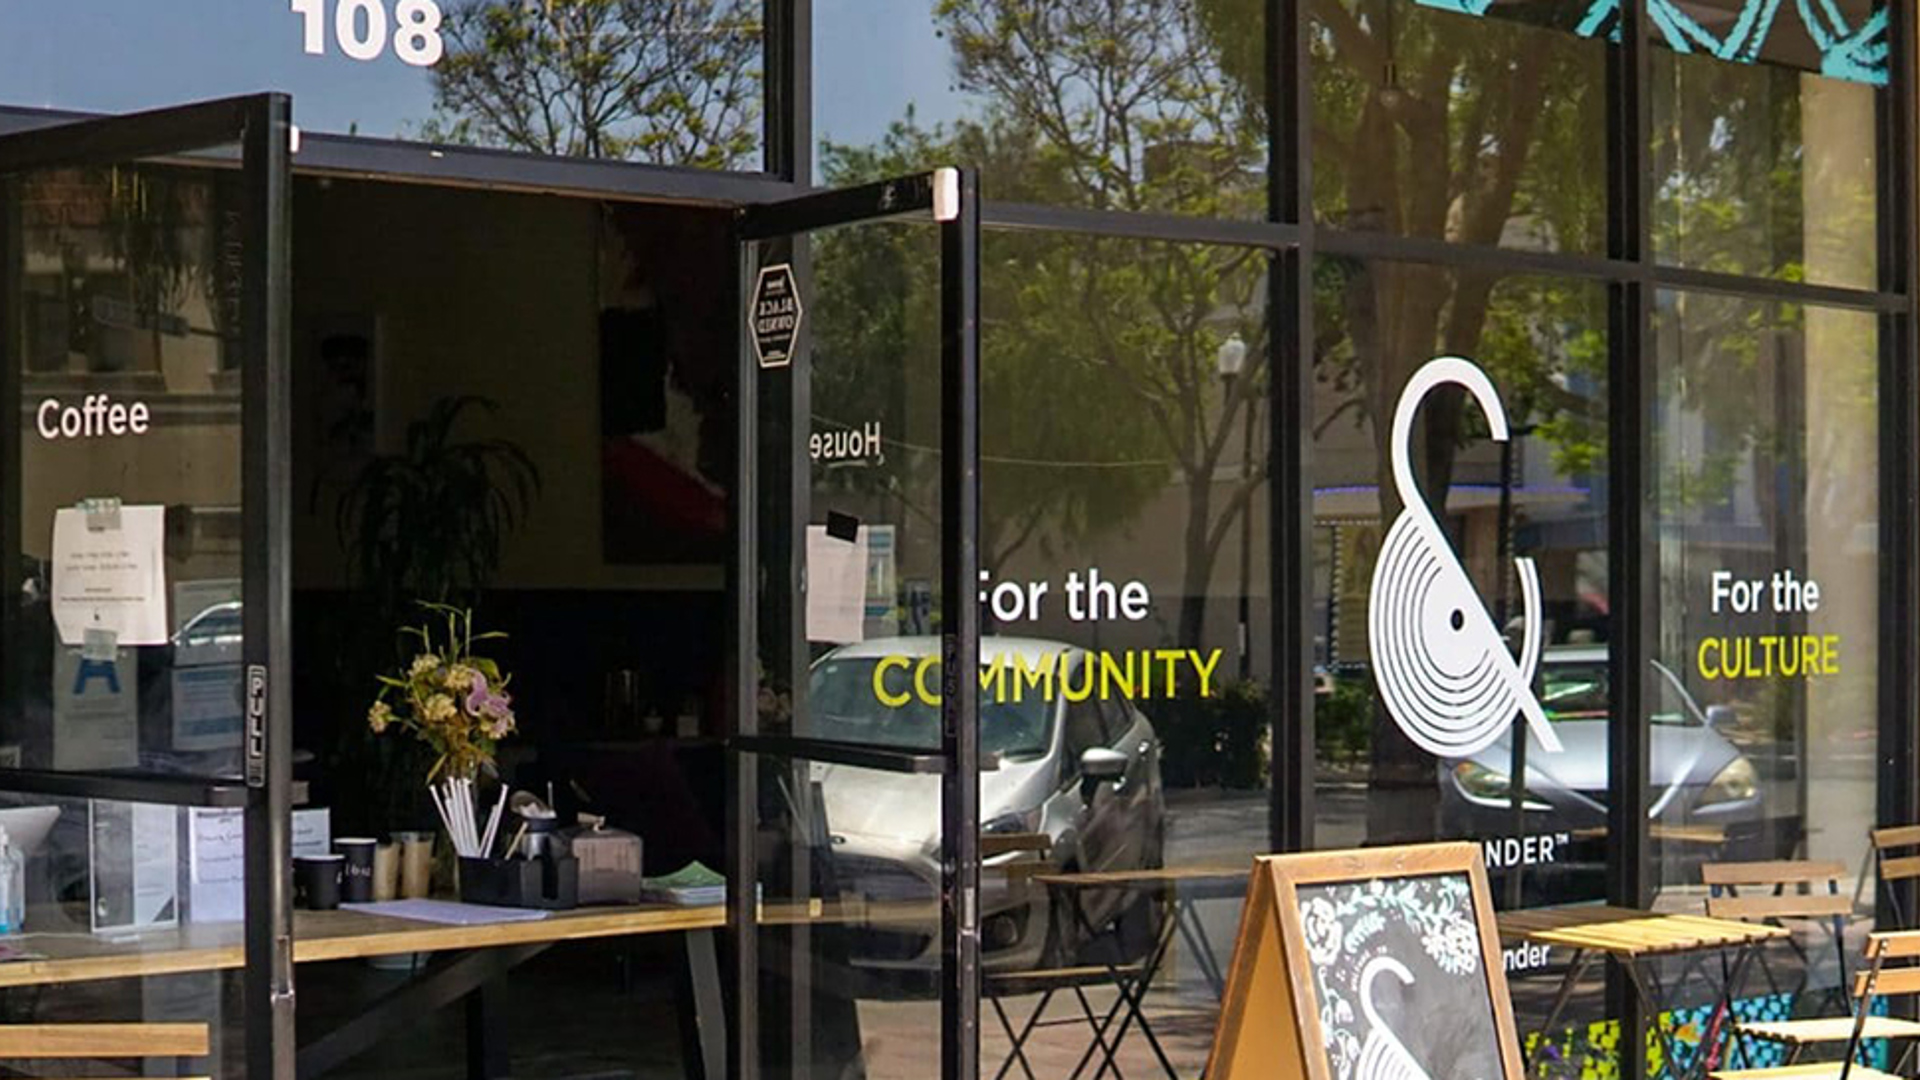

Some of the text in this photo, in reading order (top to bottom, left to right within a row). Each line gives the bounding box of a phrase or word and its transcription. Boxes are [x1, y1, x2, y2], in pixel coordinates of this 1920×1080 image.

[290, 0, 443, 66] 108
[37, 393, 149, 439] Coffee
[1065, 568, 1149, 621] the
[1711, 569, 1820, 613] For the
[872, 649, 1222, 707] COMMUNITY
[1698, 635, 1840, 680] CULTURE
[251, 677, 262, 756] PULL
[1502, 940, 1550, 971] nder
